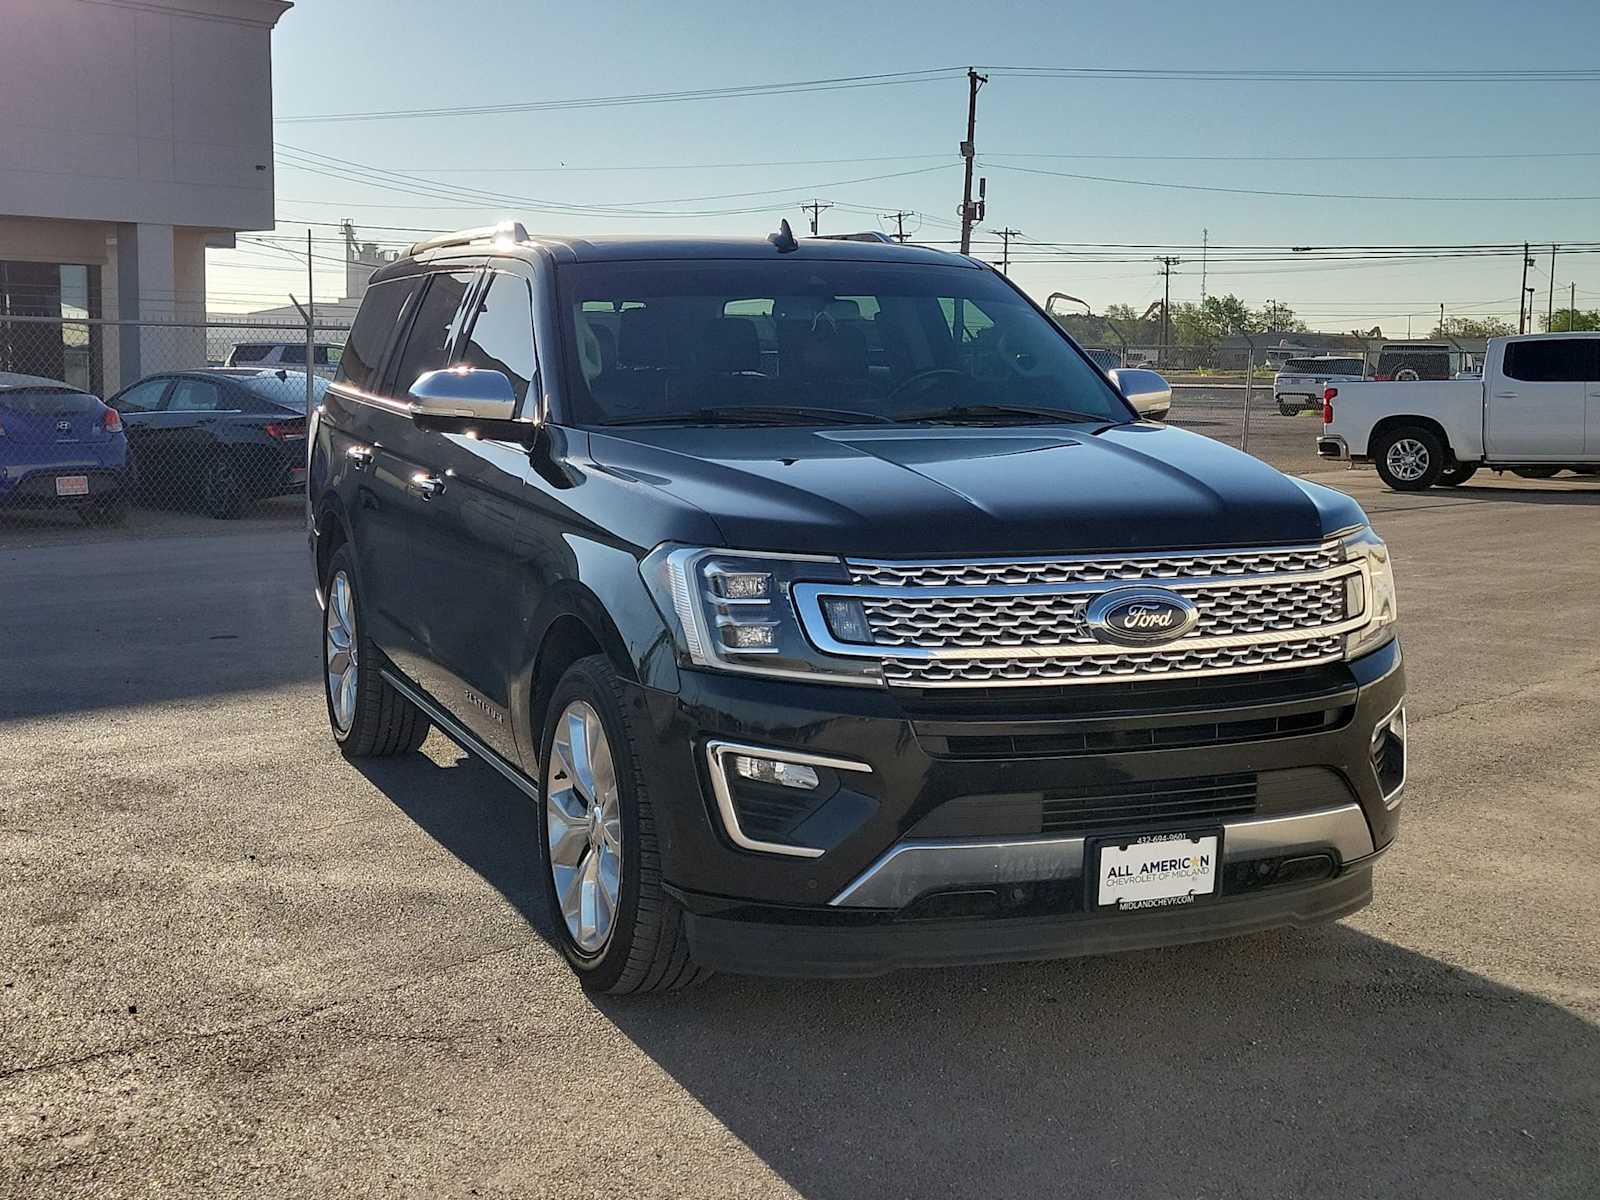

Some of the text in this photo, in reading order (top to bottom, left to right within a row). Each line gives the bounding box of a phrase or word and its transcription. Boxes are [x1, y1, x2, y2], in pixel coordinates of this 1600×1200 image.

[1124, 604, 1173, 628] Ford
[1106, 867, 1209, 887] CHEVROLET OF MIDLAND
[1107, 855, 1209, 878] ALL AMERICN
[1119, 895, 1194, 911] MIDLANDCHEVY.COM
